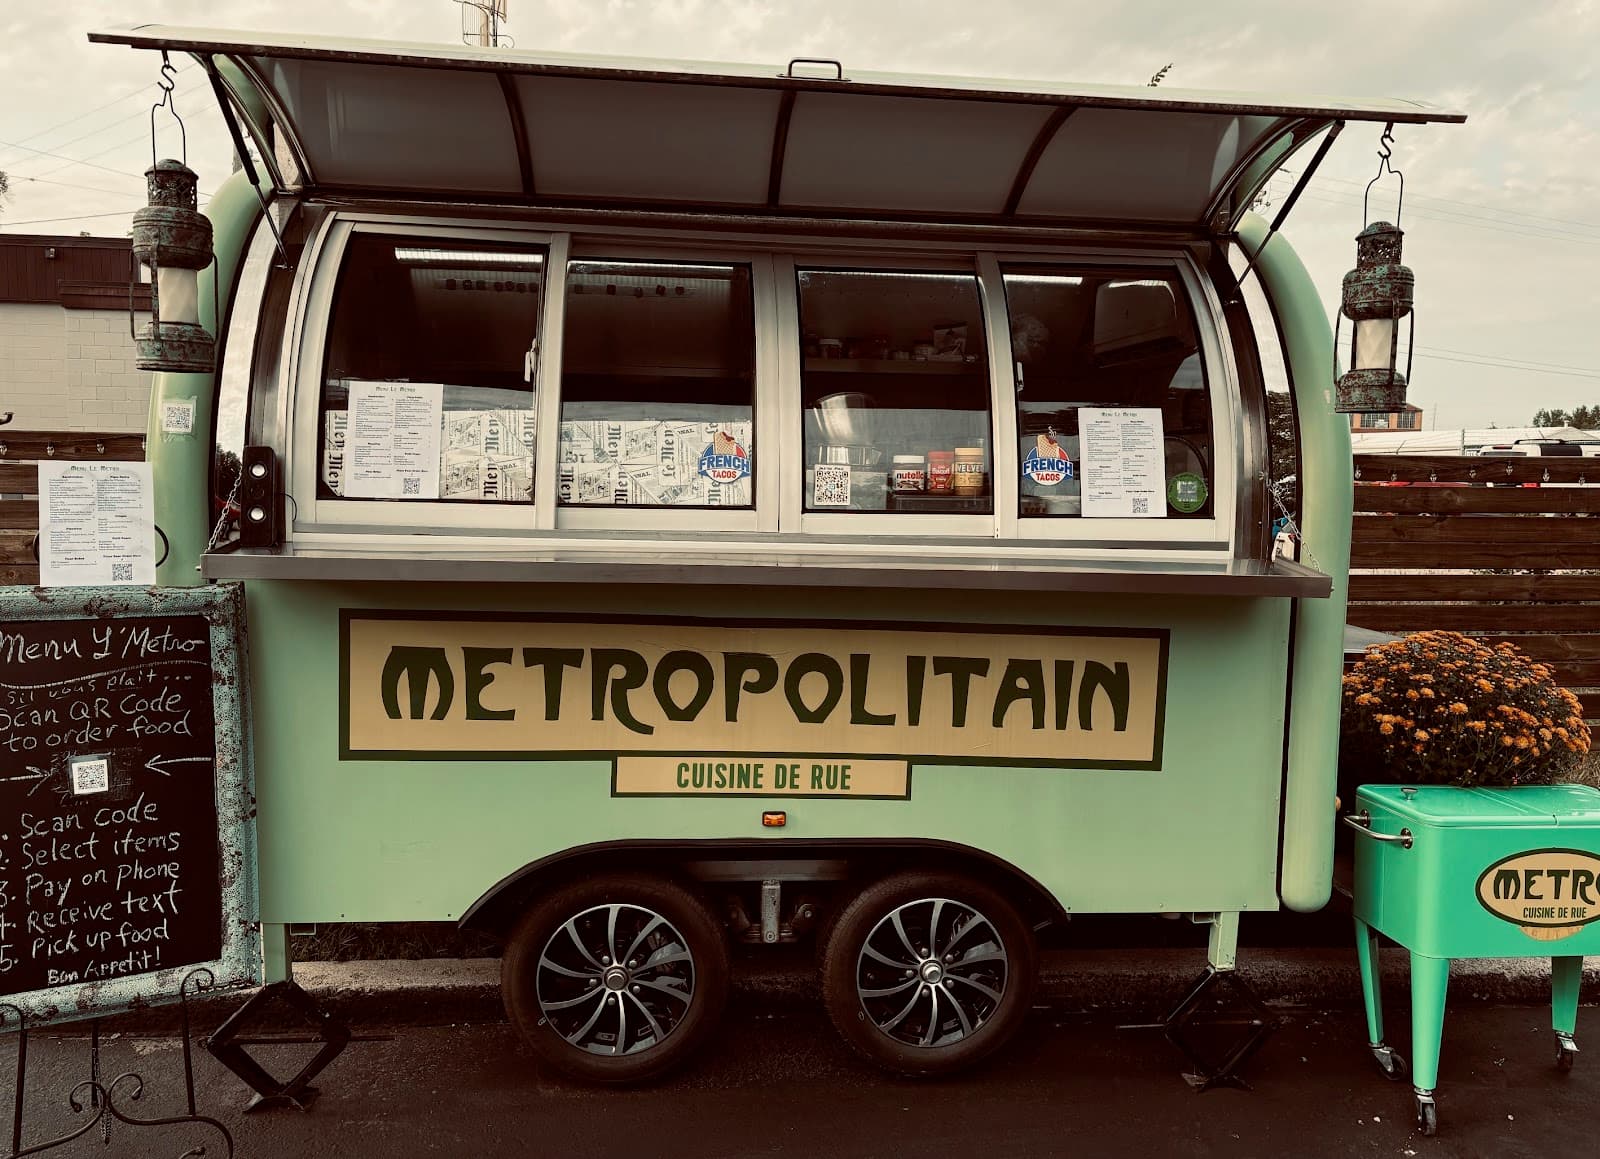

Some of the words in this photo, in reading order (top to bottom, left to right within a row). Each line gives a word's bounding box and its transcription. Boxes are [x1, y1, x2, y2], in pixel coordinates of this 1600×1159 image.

[700, 455, 750, 473] FRENCH
[712, 470, 737, 479] TACOS
[1023, 458, 1073, 475] FRENCH
[1035, 473, 1061, 482] TACOS
[0, 631, 82, 663] Menu
[49, 680, 96, 697] vous
[381, 645, 1130, 735] METROPOLITAIN
[0, 707, 60, 731] Scan
[70, 697, 112, 721] QR
[2, 732, 37, 751] to
[46, 721, 118, 746] order
[126, 709, 193, 738] food
[676, 763, 764, 789] CUISINE
[774, 764, 800, 790] DE
[810, 764, 852, 790] RUE
[20, 812, 84, 839] Scan
[21, 832, 100, 869] Select
[113, 828, 181, 855] items
[25, 873, 71, 906] Pay
[81, 868, 108, 886] on
[116, 859, 180, 891] phone
[1493, 869, 1600, 906] METR
[27, 900, 114, 934] Receive
[120, 879, 183, 915] text
[1523, 907, 1555, 918] CUISINE
[1557, 907, 1568, 918] DE
[1571, 907, 1587, 918] RUE
[31, 929, 80, 958] Pick
[86, 930, 112, 952] up
[115, 918, 170, 947] food
[48, 968, 79, 985] Bon
